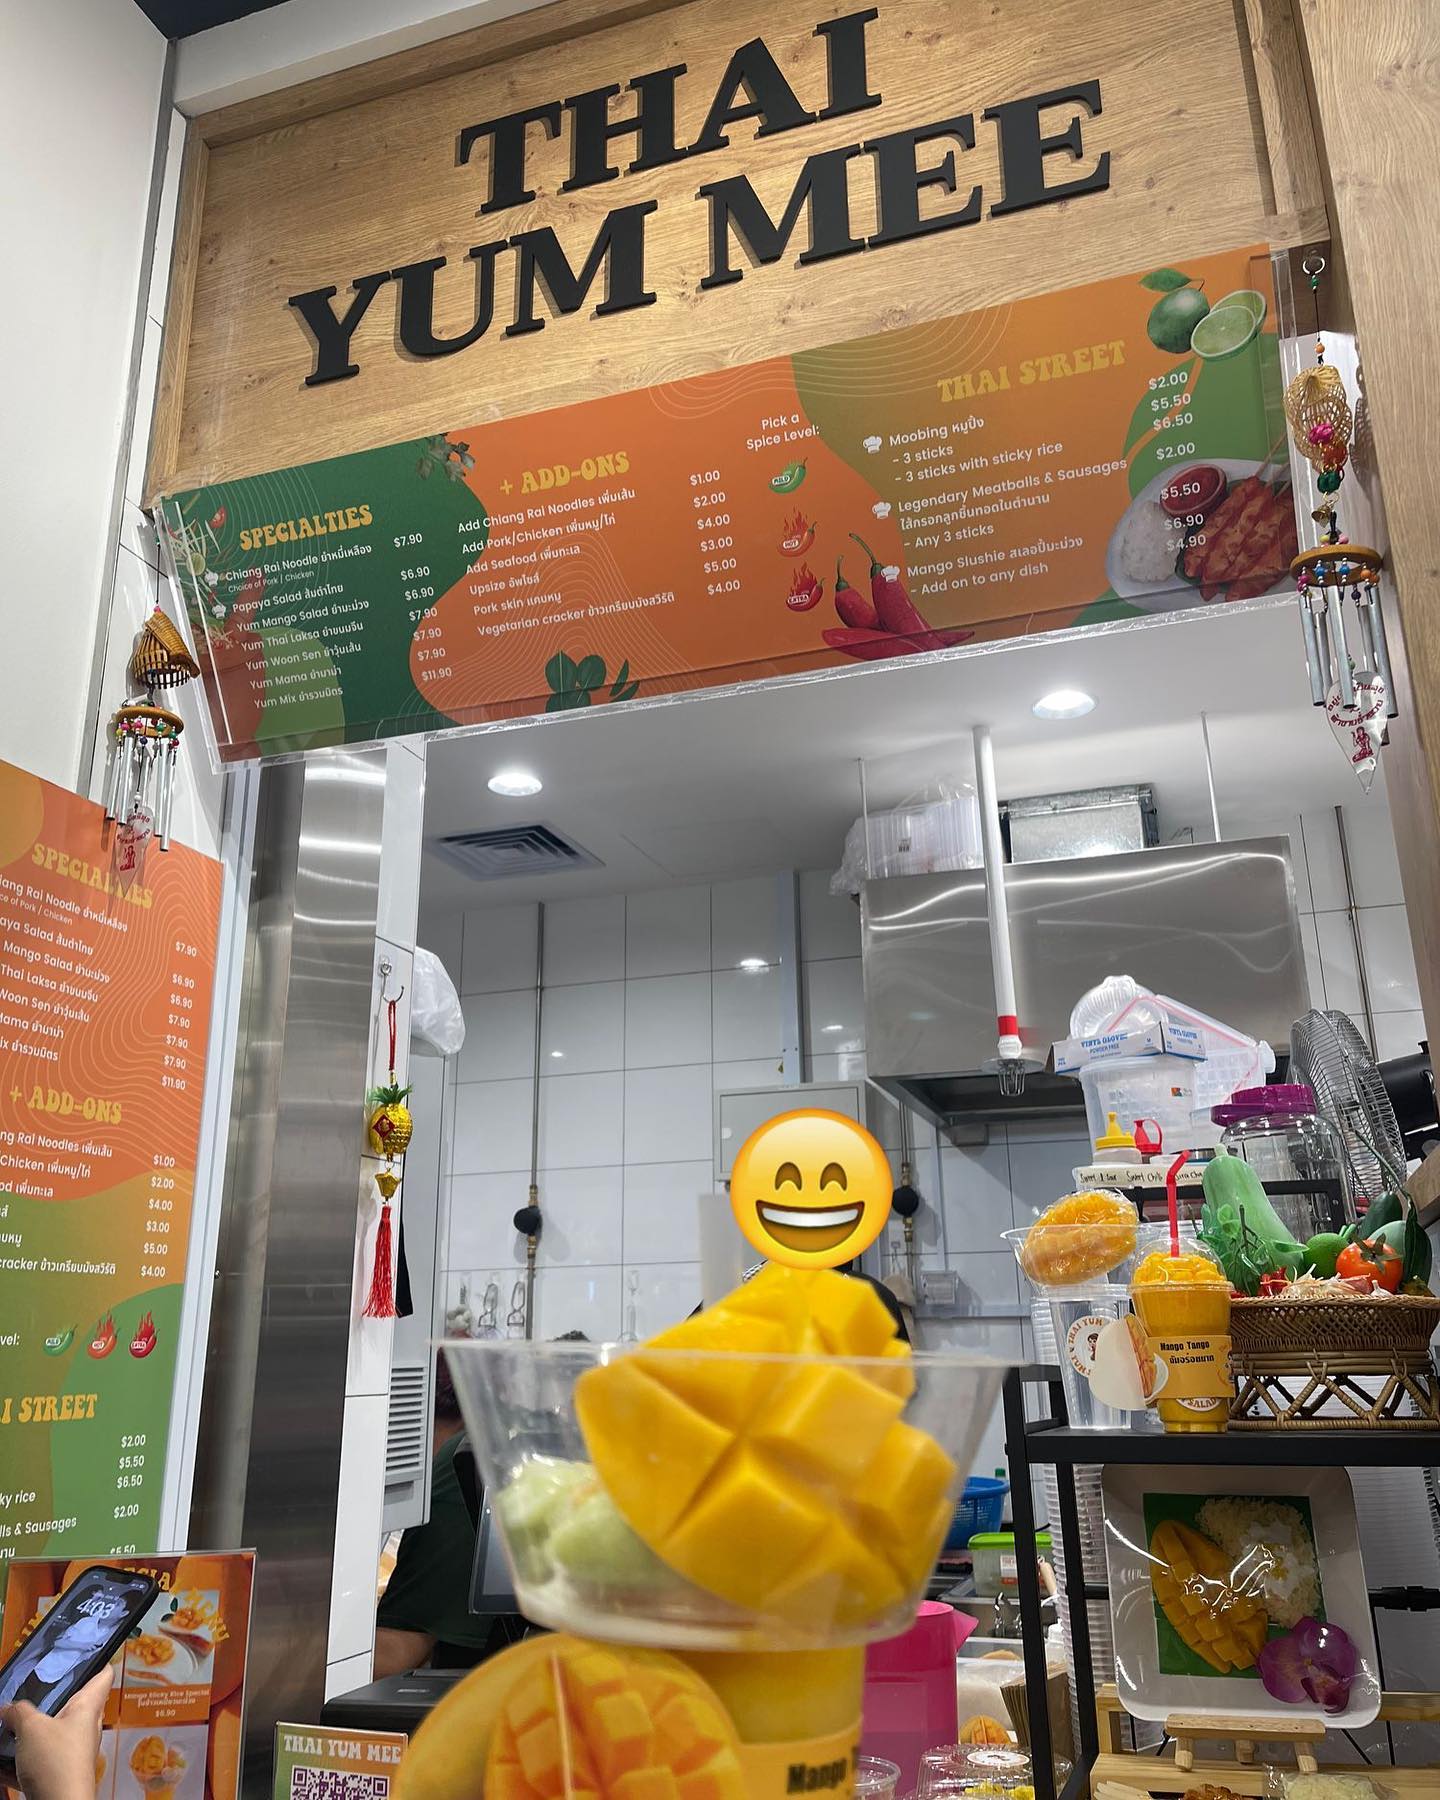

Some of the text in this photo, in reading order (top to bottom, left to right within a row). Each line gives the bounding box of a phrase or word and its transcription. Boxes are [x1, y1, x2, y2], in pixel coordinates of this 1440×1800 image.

[455, 7, 882, 215] THAI
[288, 78, 1112, 387] YUM MEE
[936, 339, 1128, 402] THAI STREET
[1148, 371, 1189, 391] $2.00
[1150, 392, 1192, 412] $5.50
[761, 413, 800, 430] Pick a
[1152, 412, 1194, 432] $6.50
[746, 425, 821, 452] Spice Level:
[890, 424, 948, 447] Moobing
[903, 445, 954, 464] 3 sticks
[1155, 442, 1196, 462] $2.00
[905, 441, 1064, 483] 3 sticks with sticky rice
[521, 451, 631, 494] ADD-ONS
[690, 470, 721, 487] $1.00
[898, 458, 1128, 514] Legendary Meatballs & Sausages
[1160, 481, 1202, 501] $5.50
[693, 492, 726, 508] $2.00
[458, 519, 481, 534] Add
[483, 509, 525, 529] Chiang
[527, 505, 545, 521] Rai
[548, 497, 596, 515] Noodles
[697, 513, 730, 530] $4.00
[1163, 513, 1205, 532] $6.90
[239, 504, 374, 551] SPECIALTIES
[915, 524, 994, 550] Any 3 sticks
[393, 533, 423, 548] $7.90
[462, 540, 485, 555] Add
[487, 526, 564, 550] Pork/Chicken
[700, 536, 733, 553] $3.00
[1166, 533, 1207, 552] $4.90
[225, 566, 263, 582] Chiang
[264, 561, 280, 574] Rai
[282, 555, 319, 571] Noodle
[466, 561, 488, 576] Add
[491, 551, 537, 571] Seafood
[703, 557, 737, 575] $5.00
[907, 549, 1006, 579] Mango Slushie
[400, 566, 431, 581] $6.90
[921, 562, 1049, 596] Add on to any dish
[404, 586, 434, 602] $6.90
[469, 580, 506, 597] Upsize
[707, 579, 741, 597] $4.00
[232, 599, 271, 614] Papaya
[273, 590, 302, 606] Salad
[473, 602, 498, 616] Pork
[501, 597, 524, 611] skin
[236, 621, 261, 633] Yum
[262, 614, 298, 628] Mango
[300, 606, 329, 621] Salad
[408, 607, 438, 622] $7.90
[477, 608, 585, 637] Vegetarian cracker
[241, 640, 265, 652] Yum
[266, 635, 289, 648] Thai
[291, 629, 321, 643] Laksa
[413, 628, 442, 642] $7.90
[245, 659, 269, 671] Yum
[271, 653, 301, 666] Woon
[302, 649, 322, 662] Sen
[417, 647, 446, 662] $7.90
[250, 678, 274, 690] Yum
[275, 672, 308, 685] Mama
[421, 667, 452, 682] $11.90
[254, 697, 278, 709] Yum
[279, 692, 297, 705] Mix
[26, 886, 81, 914] Rai Noodle
[23, 922, 54, 942] Salad
[3, 939, 73, 973] Mango Salad
[175, 940, 197, 958] $7.90
[0, 963, 57, 991] Thai Laksa
[172, 973, 195, 990] $6.90
[31, 997, 51, 1013] Sen
[170, 993, 193, 1010] $6.90
[168, 1013, 191, 1029] $7.90
[165, 1034, 189, 1050] $7.90
[163, 1055, 187, 1070] $7.90
[27, 1085, 123, 1125] ADD-ONS
[17, 1133, 79, 1152] Rai Noodles
[153, 1154, 176, 1168] $1.00
[151, 1176, 175, 1190] $2.00
[148, 1198, 173, 1212] $4.00
[146, 1219, 170, 1233] $3.00
[143, 1241, 168, 1256] $5.00
[140, 1264, 166, 1278] $4.00
[1160, 1340, 1210, 1352] Mango Tango
[18, 1394, 98, 1424] STREET
[121, 1434, 147, 1449] $2.00
[119, 1455, 145, 1470] $5.50
[116, 1474, 143, 1489] $6.50
[15, 1490, 36, 1504] rice
[113, 1503, 139, 1519] $2.00
[14, 1517, 77, 1535] & Sausages
[76, 1599, 116, 1620] 4:03
[283, 1734, 401, 1763] THAI YUM MEE
